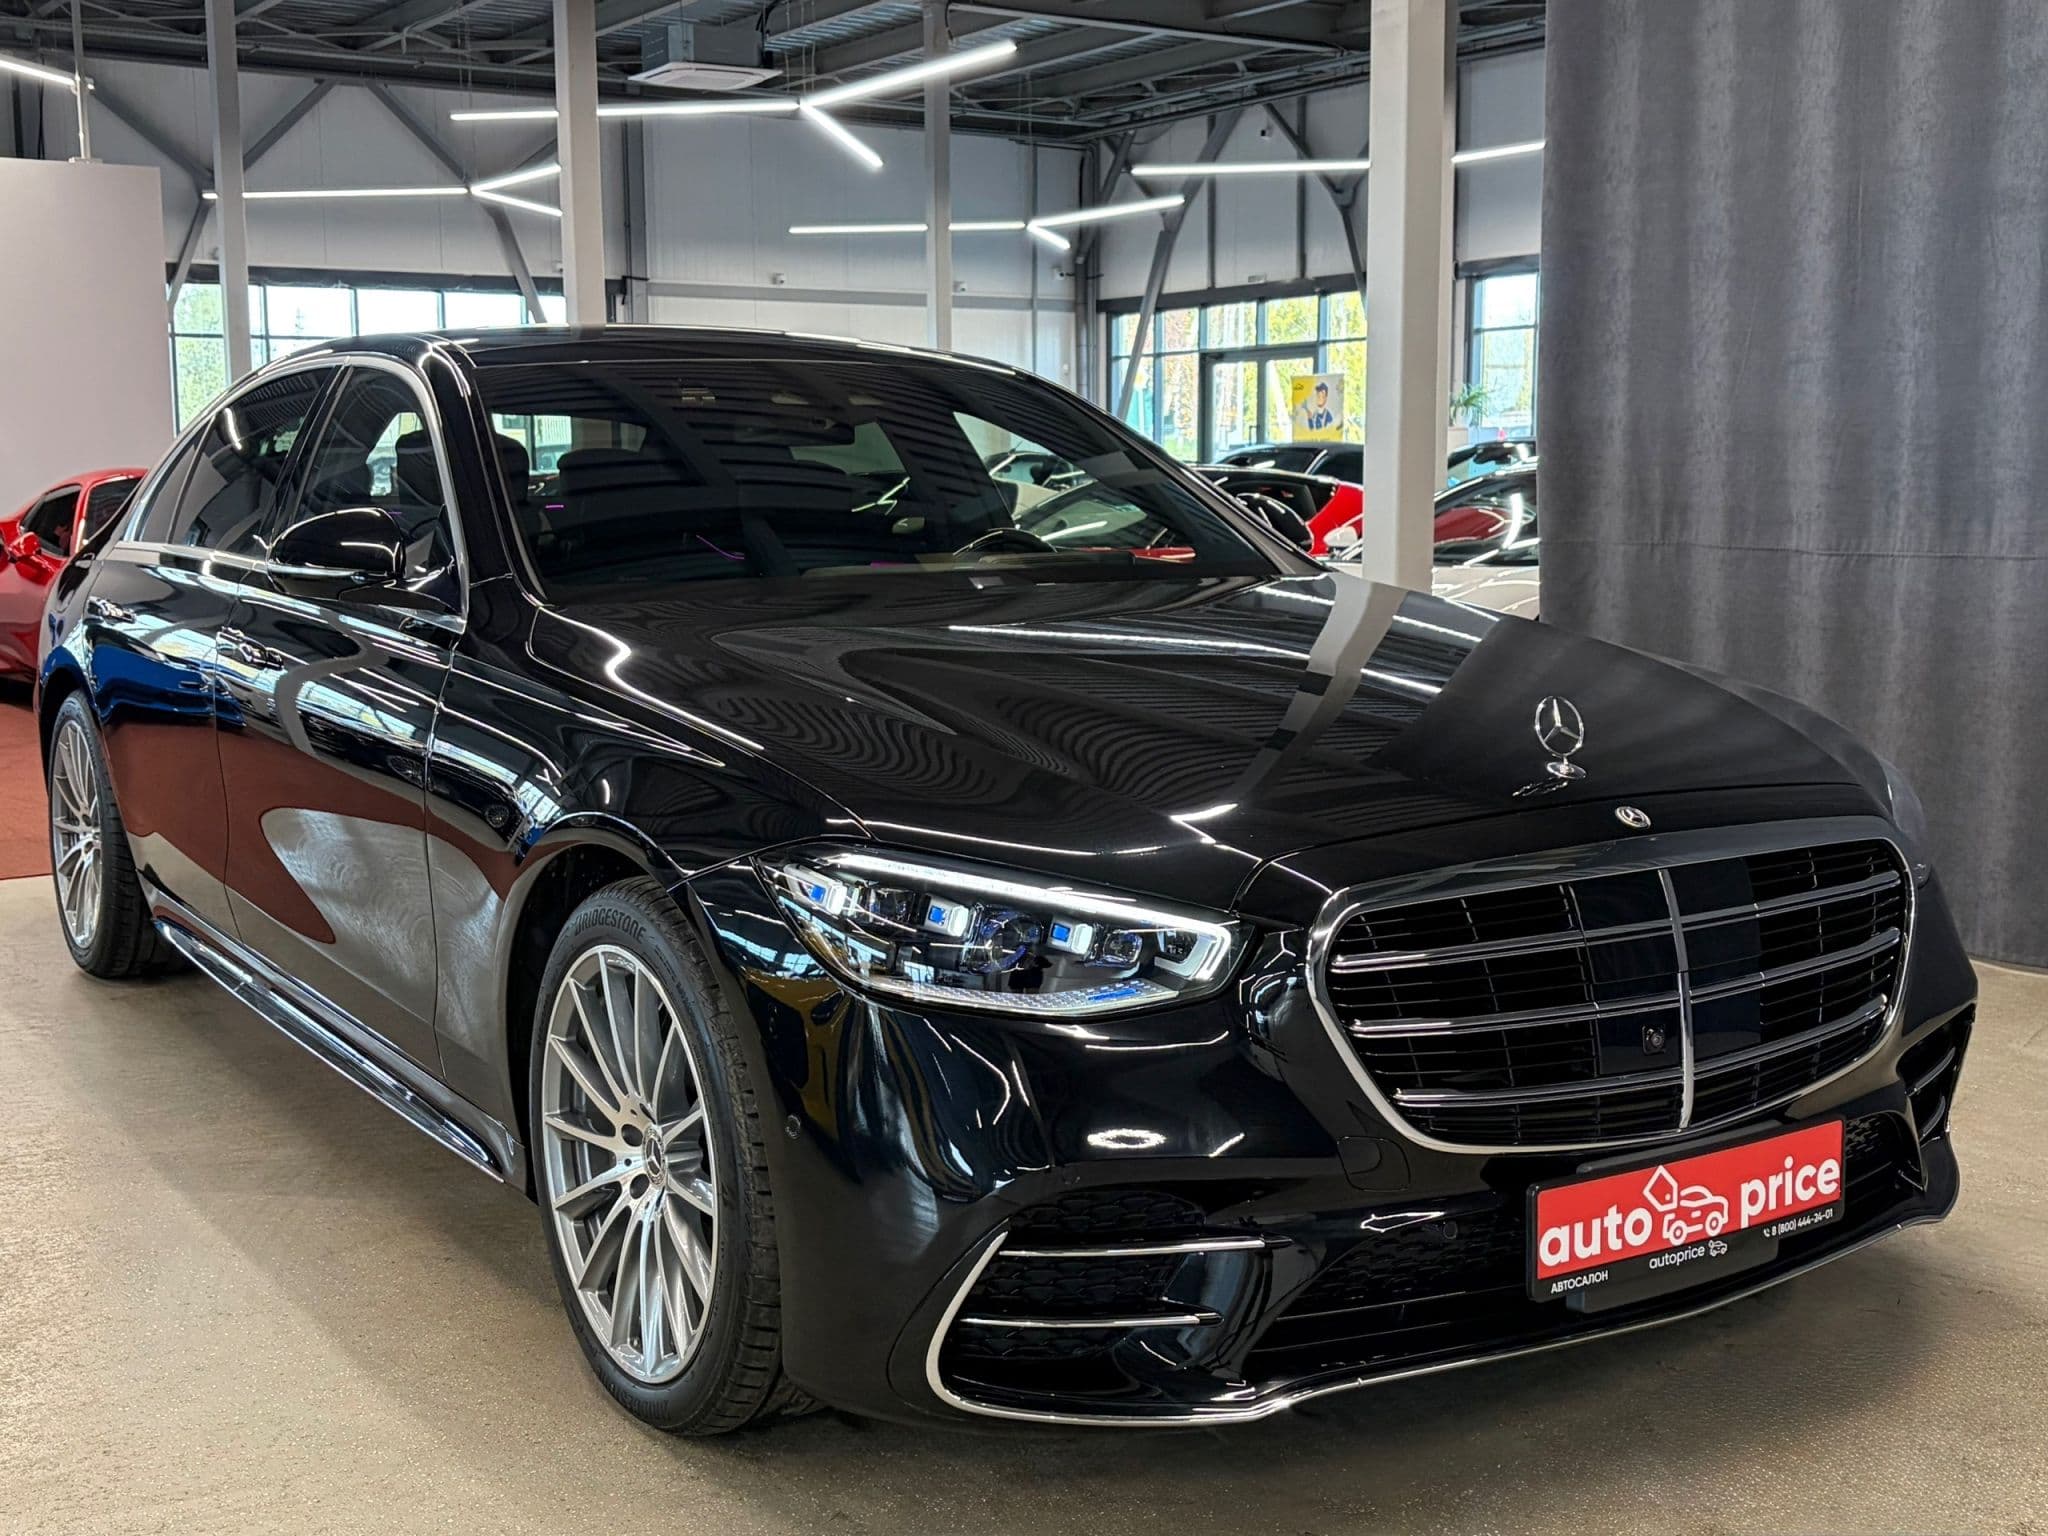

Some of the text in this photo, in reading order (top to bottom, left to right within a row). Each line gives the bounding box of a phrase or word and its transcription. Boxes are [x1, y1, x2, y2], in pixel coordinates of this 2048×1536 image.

[575, 908, 647, 943] BRIDGESTONE
[1540, 1156, 1840, 1266] auto price
[1649, 1244, 1705, 1269] autoprice
[1551, 1270, 1608, 1294] АВТОСАЛОН
